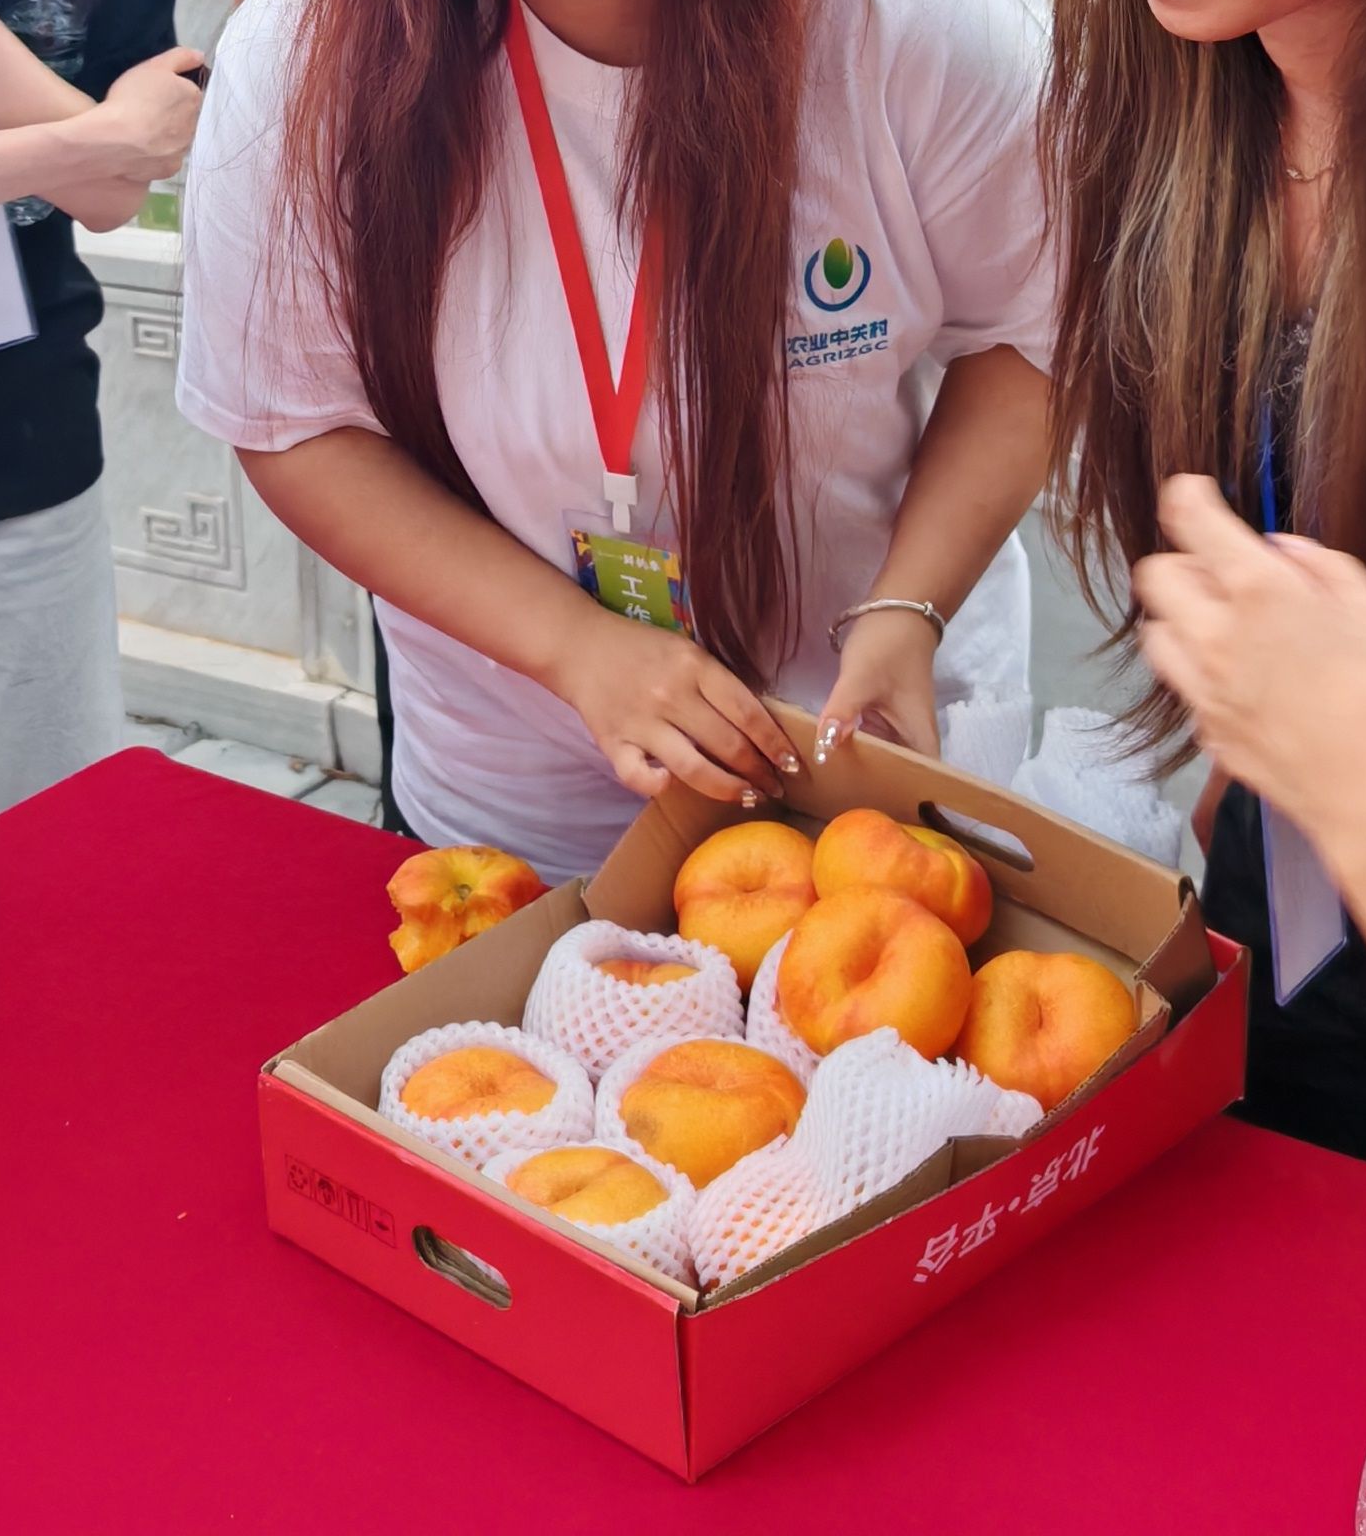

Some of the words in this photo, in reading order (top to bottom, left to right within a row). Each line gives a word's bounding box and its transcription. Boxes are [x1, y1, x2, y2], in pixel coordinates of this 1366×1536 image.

[787, 319, 889, 354] 农业中关村
[788, 340, 889, 369] AGRIZGC
